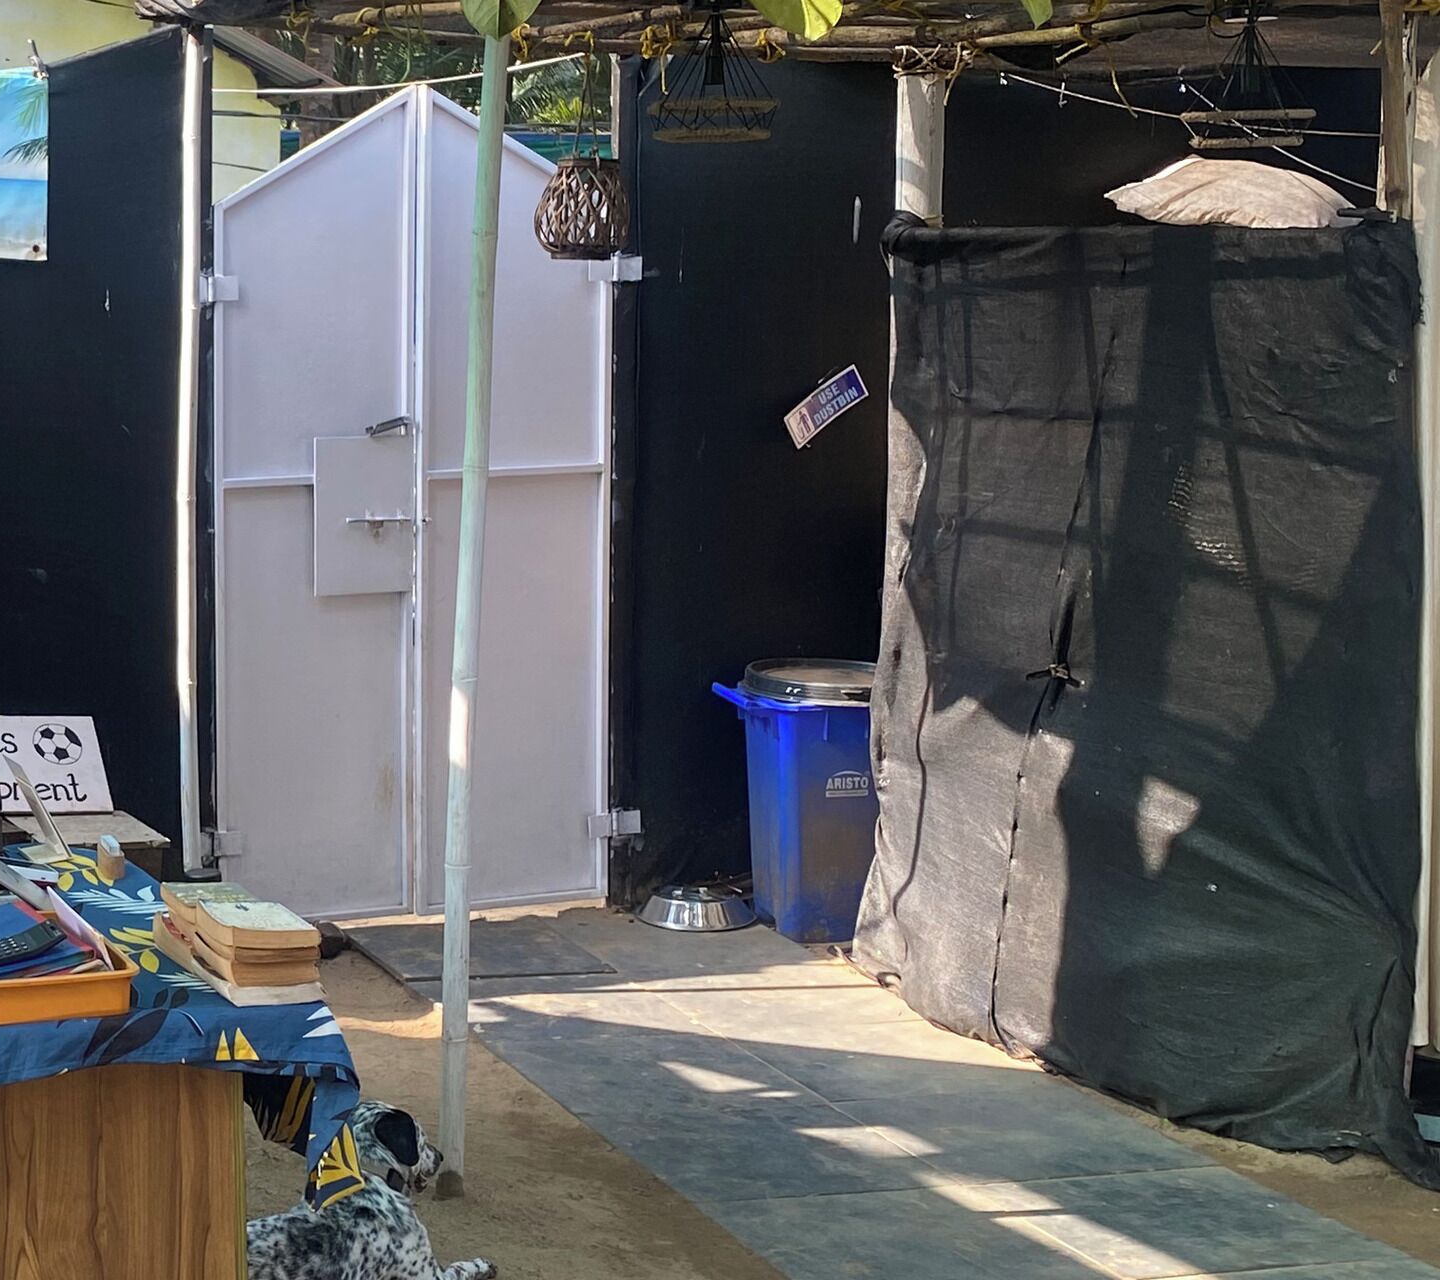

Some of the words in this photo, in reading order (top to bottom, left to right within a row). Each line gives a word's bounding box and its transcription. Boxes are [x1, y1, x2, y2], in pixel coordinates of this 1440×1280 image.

[818, 383, 839, 404] USE
[814, 387, 858, 425] DUSTBIN
[825, 776, 869, 790] ARISTO
